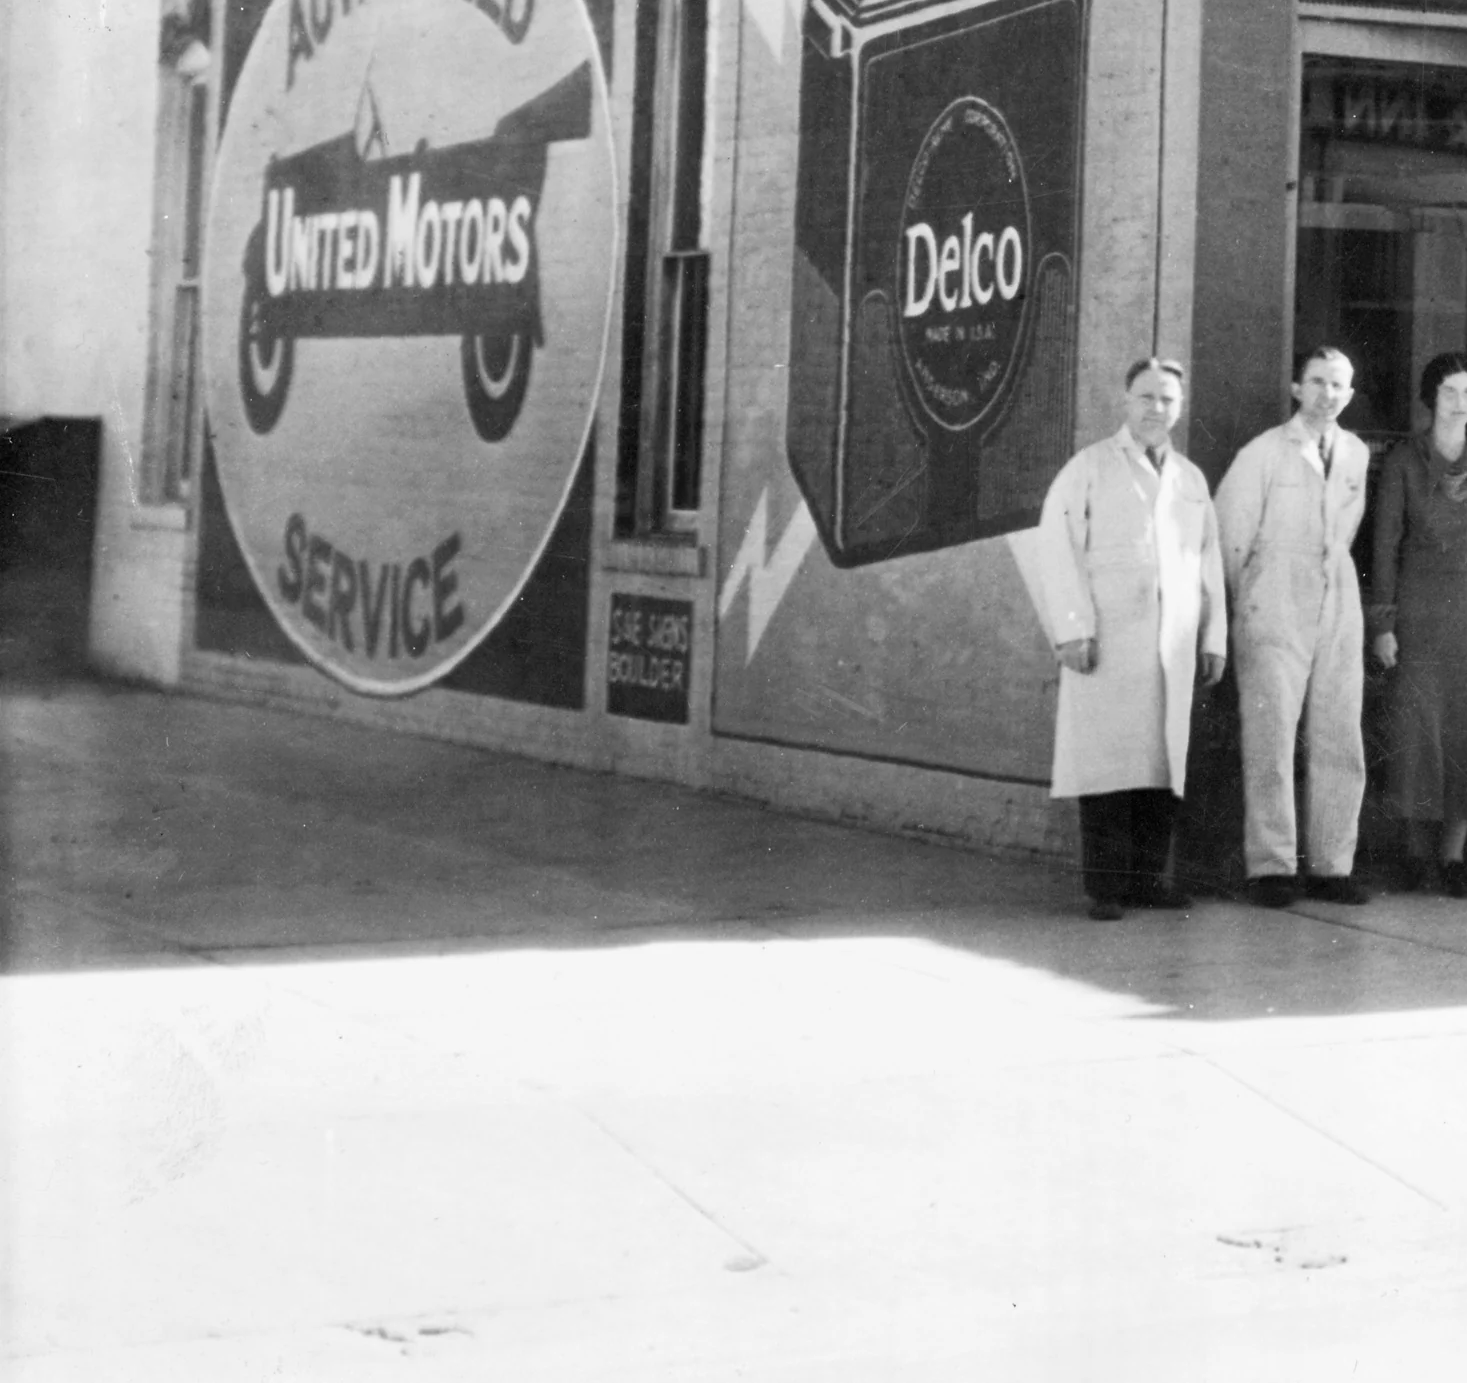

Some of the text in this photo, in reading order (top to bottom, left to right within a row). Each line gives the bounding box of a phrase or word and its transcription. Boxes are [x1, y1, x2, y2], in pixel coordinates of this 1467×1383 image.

[265, 171, 529, 297] UNITED MOTORS
[904, 212, 1023, 317] Delco
[276, 512, 464, 661] SERVICE
